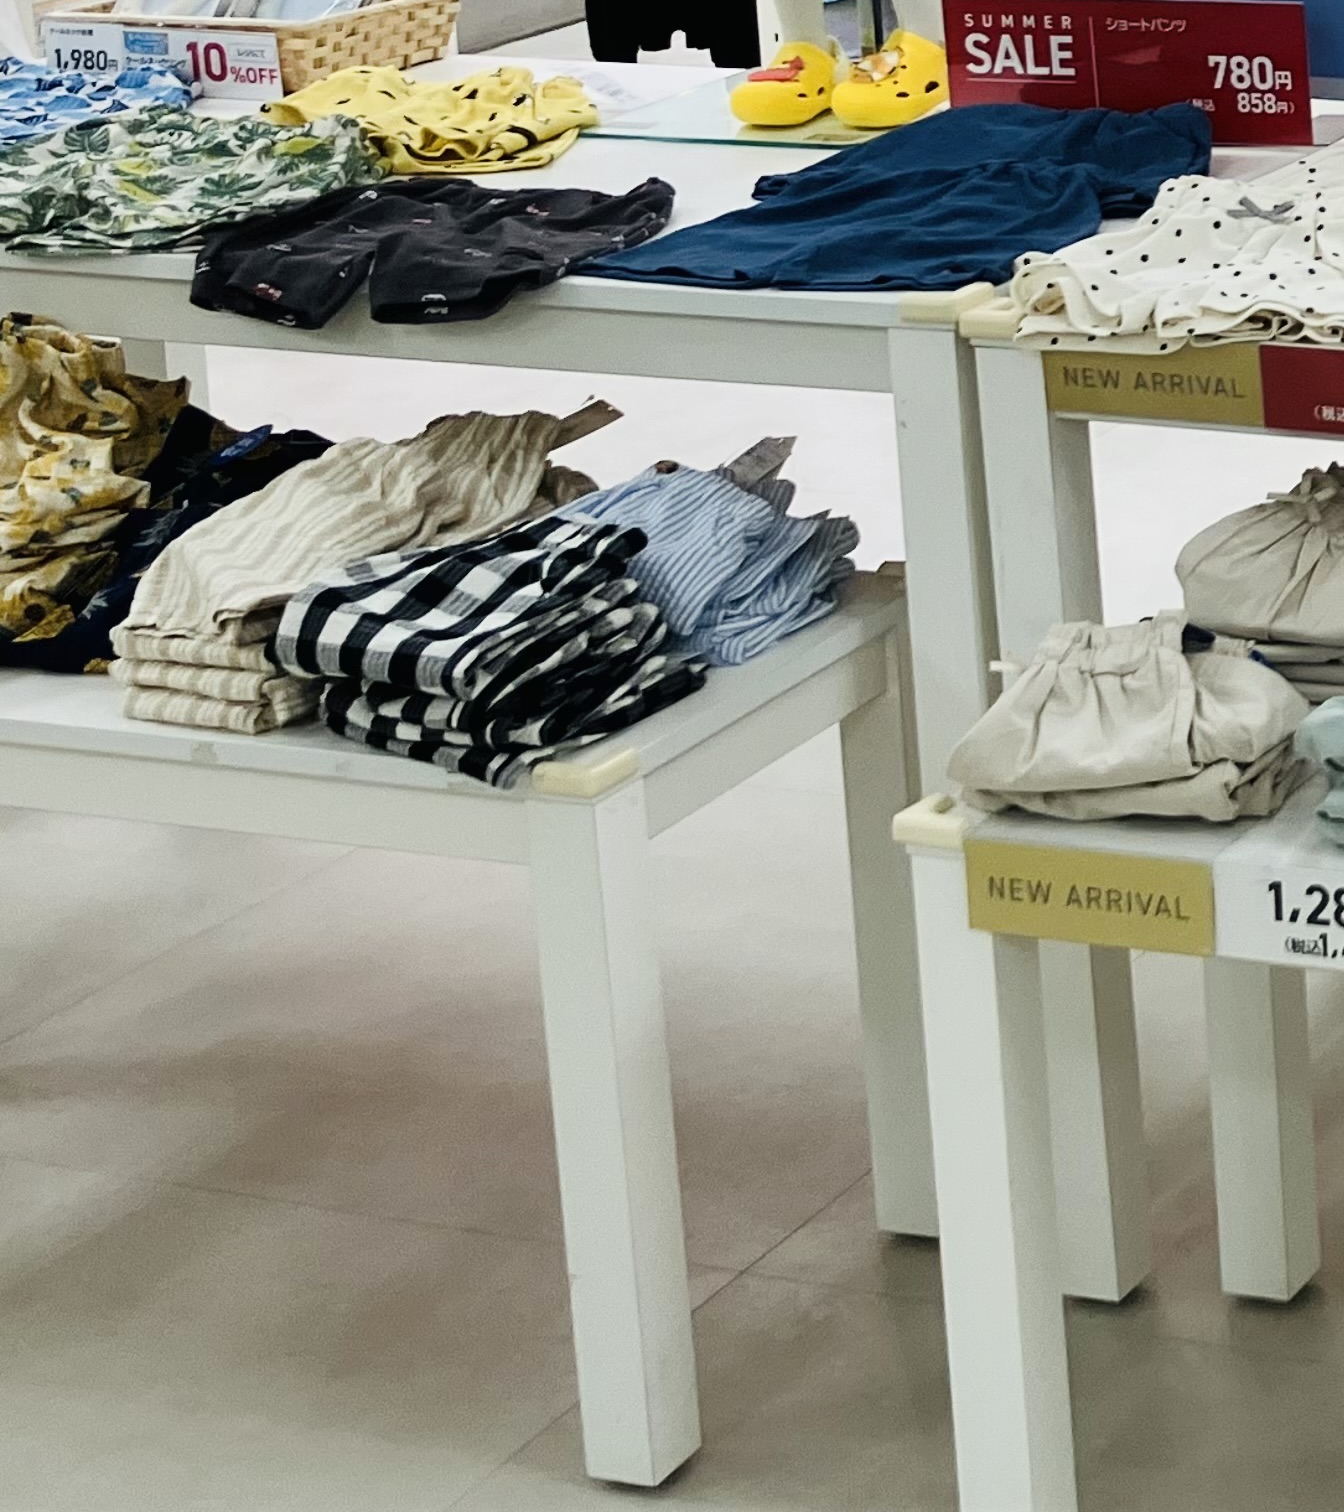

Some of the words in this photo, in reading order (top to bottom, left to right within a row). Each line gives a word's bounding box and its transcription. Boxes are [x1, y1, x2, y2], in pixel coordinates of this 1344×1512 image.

[964, 13, 1072, 29] SUMMER
[1105, 17, 1187, 32] ショートパンツ
[54, 48, 119, 71] 1,980円
[186, 41, 228, 83] 10
[230, 65, 278, 85] %OFF
[964, 32, 1076, 76] SALE
[1207, 54, 1293, 90] 780円
[1237, 93, 1296, 115] 858円)
[1063, 366, 1120, 389] NEW
[1134, 371, 1247, 399] ARRIVAL
[987, 875, 1052, 905] NEW
[1066, 885, 1192, 922] ARRIVAL
